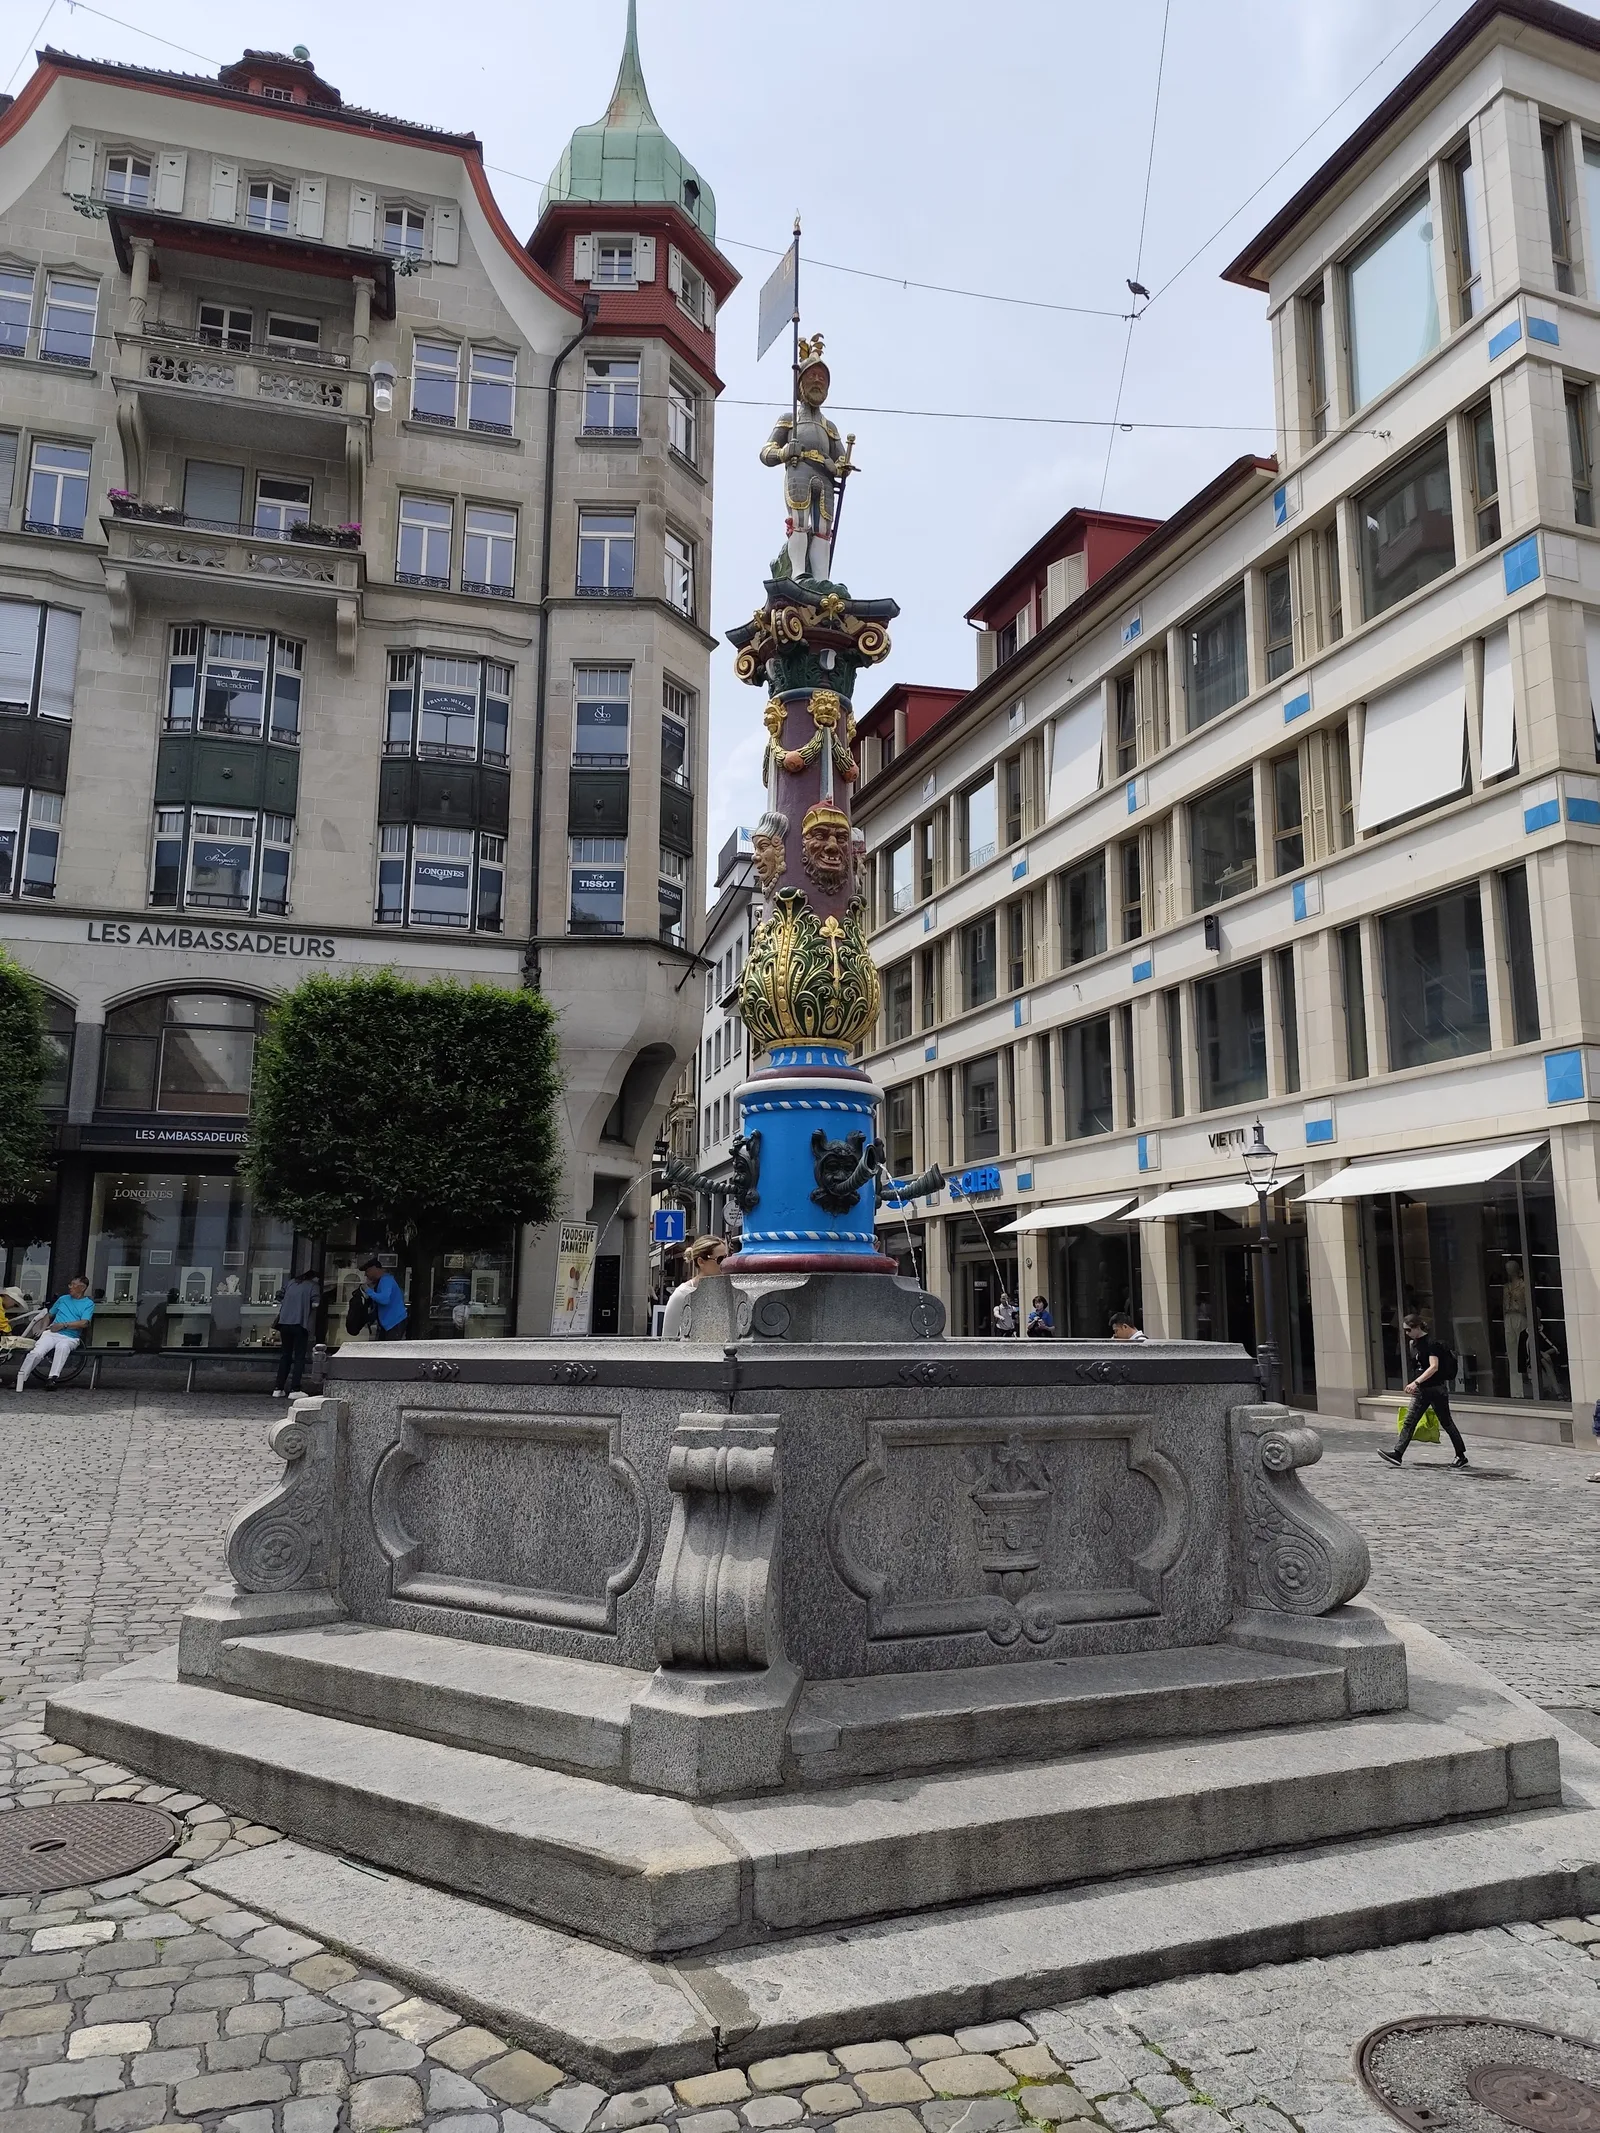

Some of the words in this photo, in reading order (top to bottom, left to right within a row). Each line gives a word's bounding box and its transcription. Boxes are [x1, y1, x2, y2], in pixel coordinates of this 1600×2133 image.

[426, 697, 448, 706] FRANCK
[450, 697, 472, 711] MULLER
[418, 867, 465, 878] LONGINES
[579, 880, 616, 888] TISSOT
[87, 922, 131, 944] LES
[136, 926, 336, 958] AMBASSADEURS
[135, 1130, 156, 1140] LES
[157, 1131, 248, 1143] AMBASSADEURS
[114, 1189, 174, 1199] LONGINES
[561, 1227, 595, 1243] FOODSAVE
